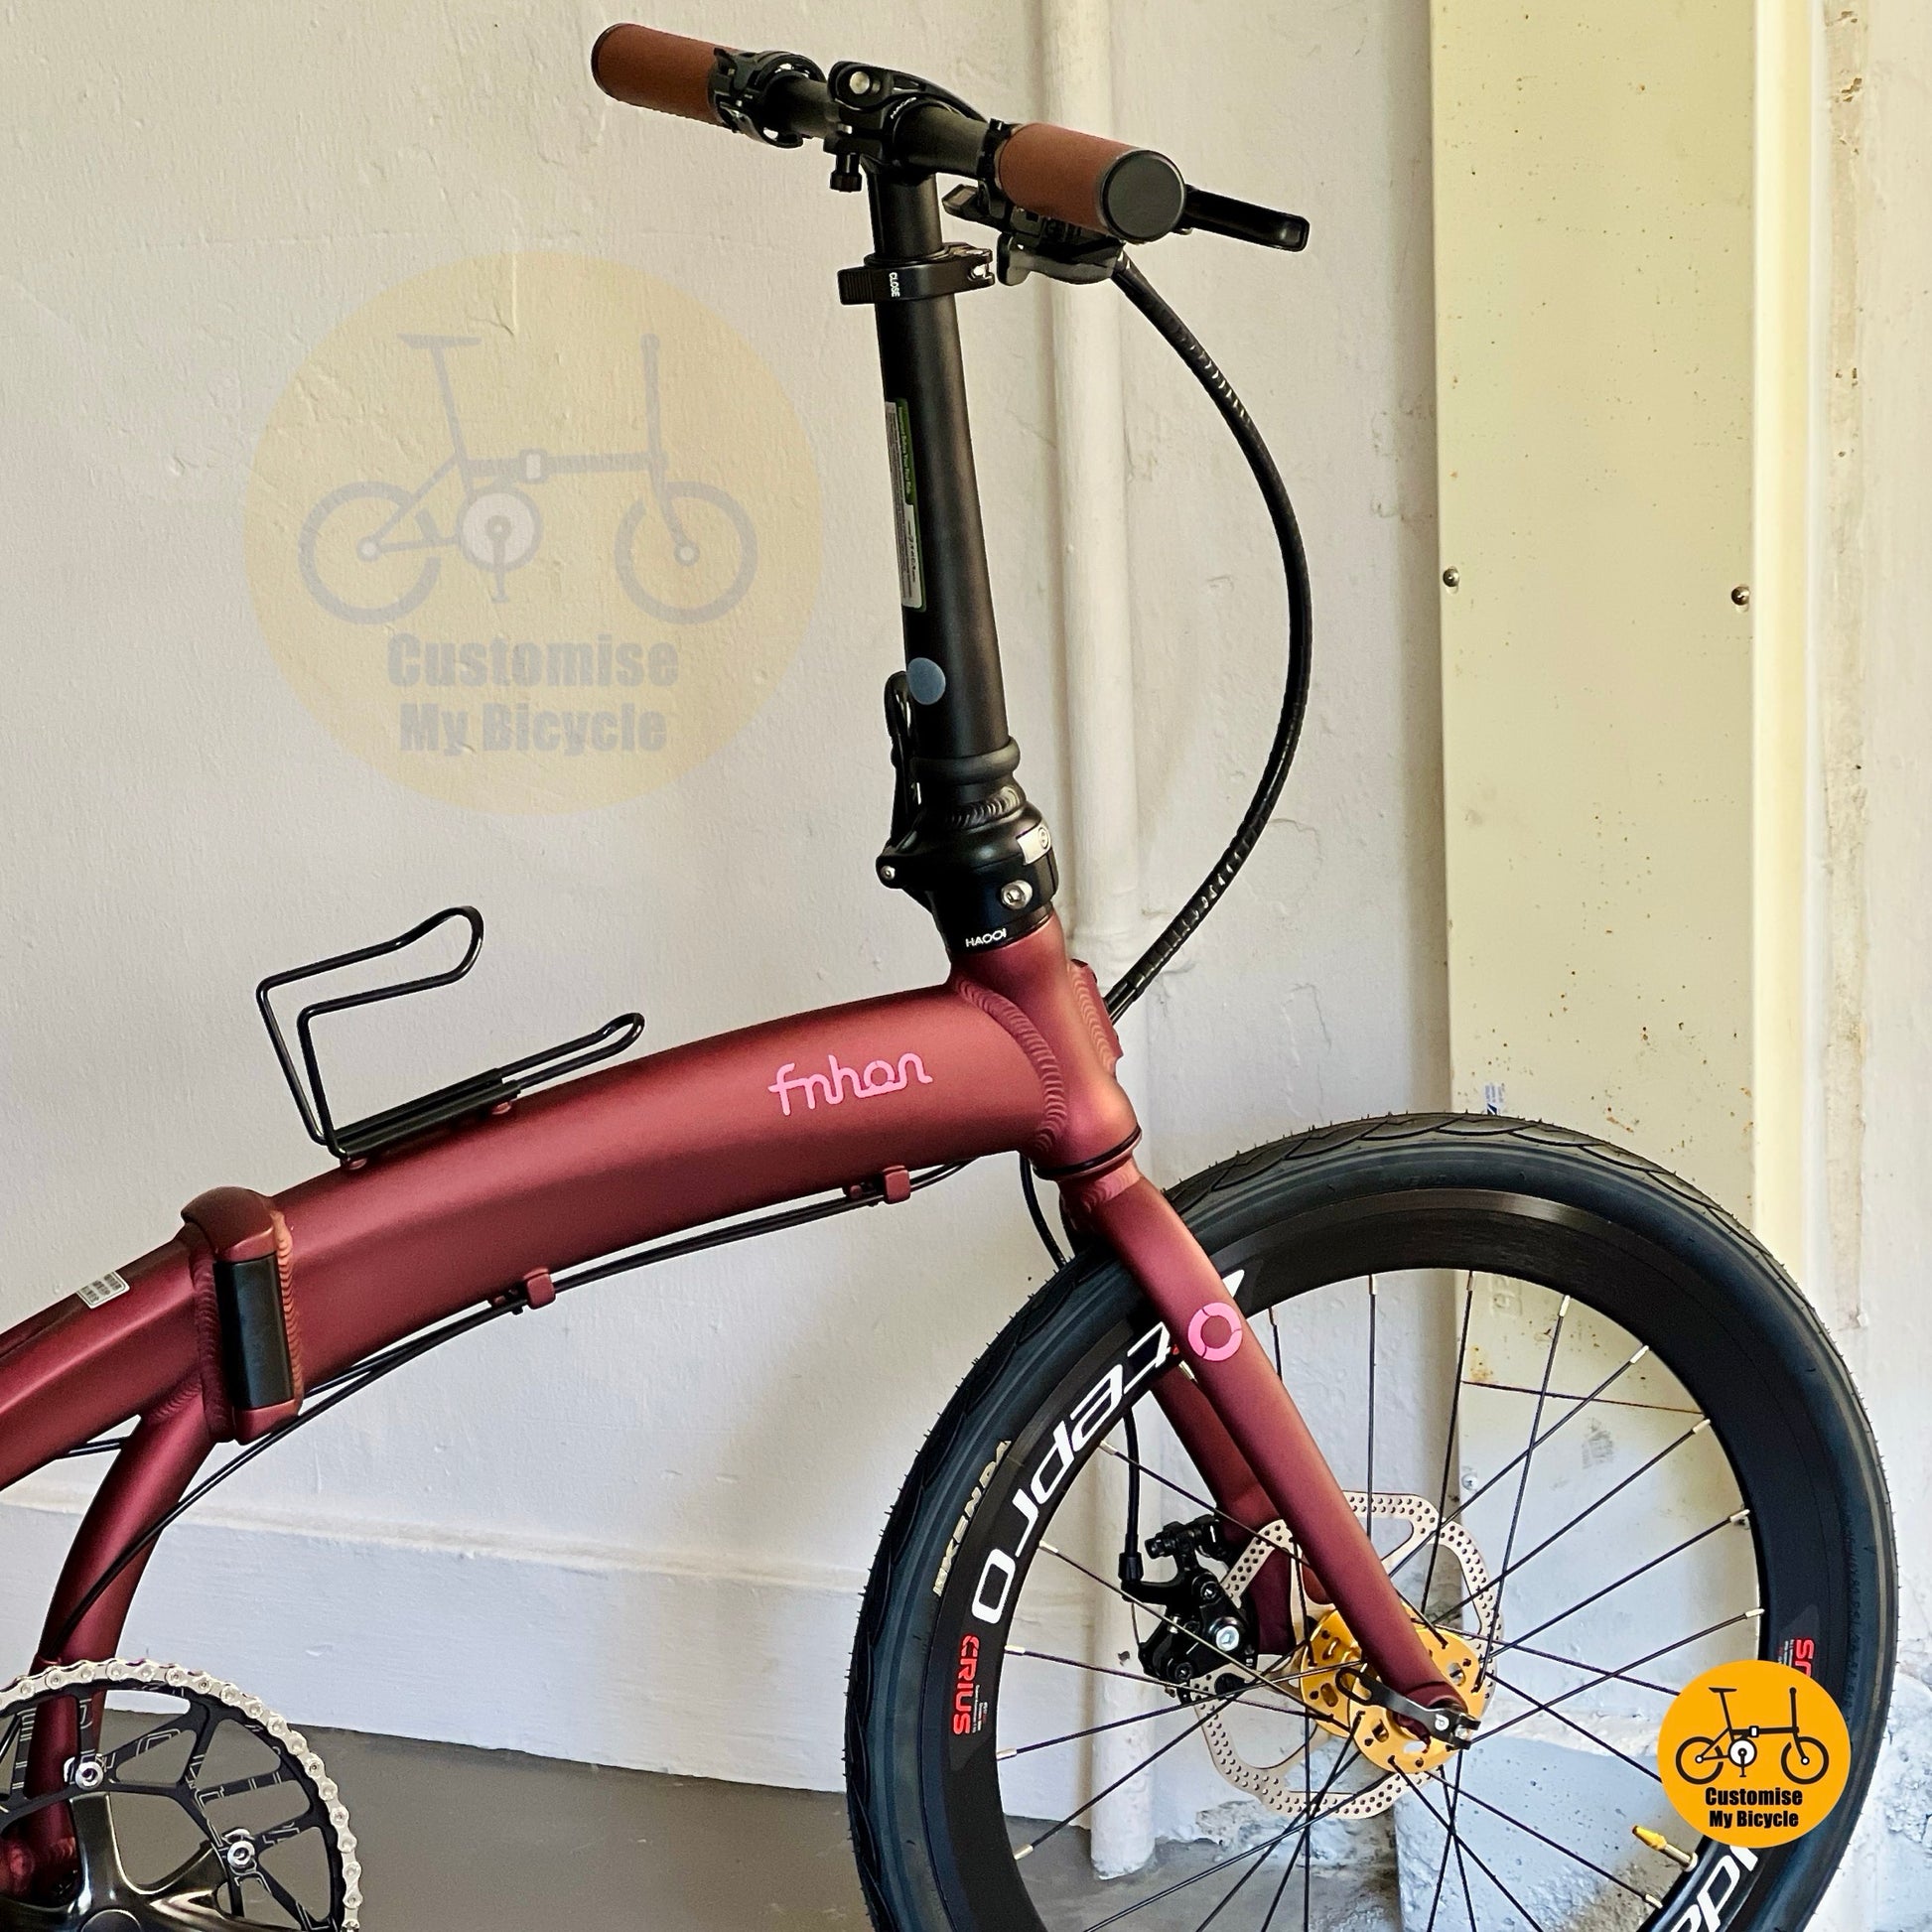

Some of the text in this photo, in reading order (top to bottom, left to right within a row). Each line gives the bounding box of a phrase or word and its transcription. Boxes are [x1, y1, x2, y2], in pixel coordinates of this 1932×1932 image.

[889, 272, 900, 298] CLOSE
[972, 1270, 1245, 1624] tepro
[941, 1441, 1012, 1573] KENDA
[954, 1635, 980, 1734] CRIUS
